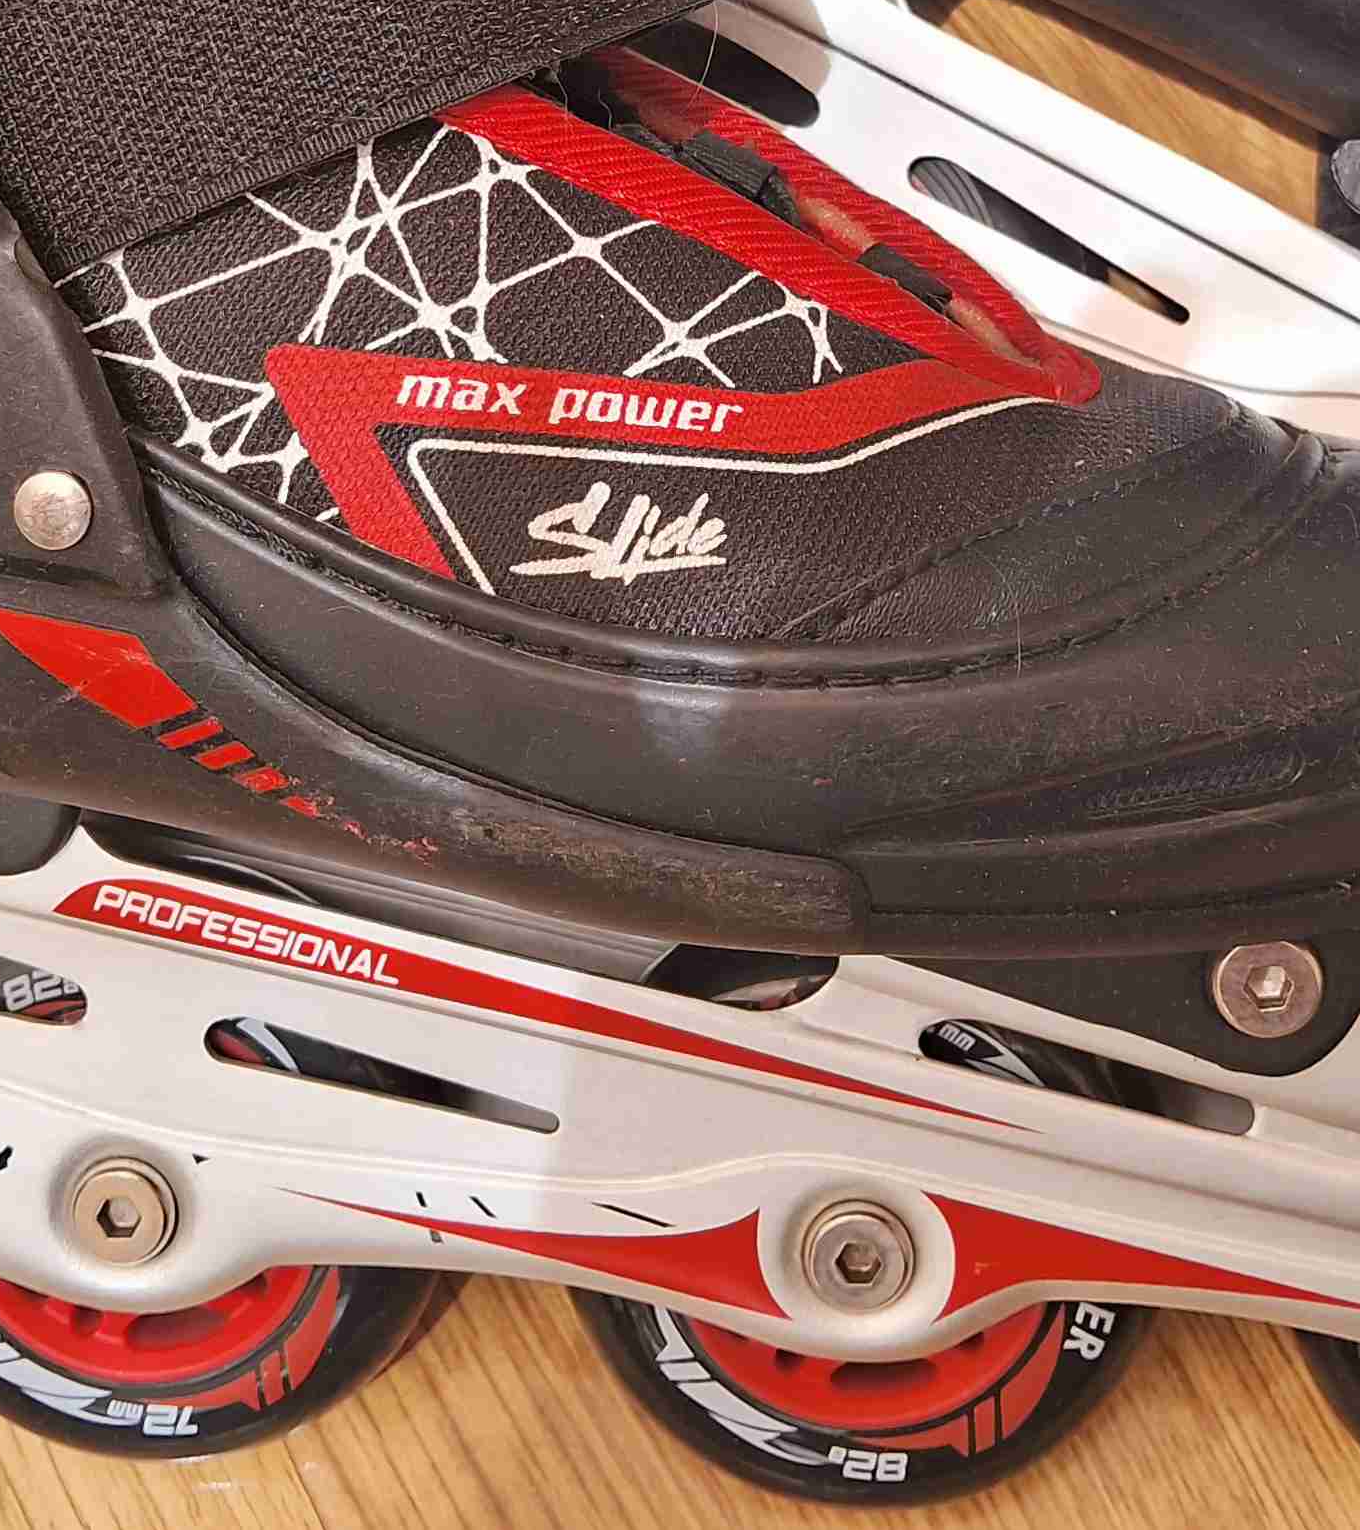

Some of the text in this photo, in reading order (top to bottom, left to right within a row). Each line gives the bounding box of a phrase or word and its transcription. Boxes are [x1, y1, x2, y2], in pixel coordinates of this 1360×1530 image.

[395, 374, 744, 434] max power
[509, 480, 728, 586] Slide
[94, 884, 400, 986] PROFESSIONAL
